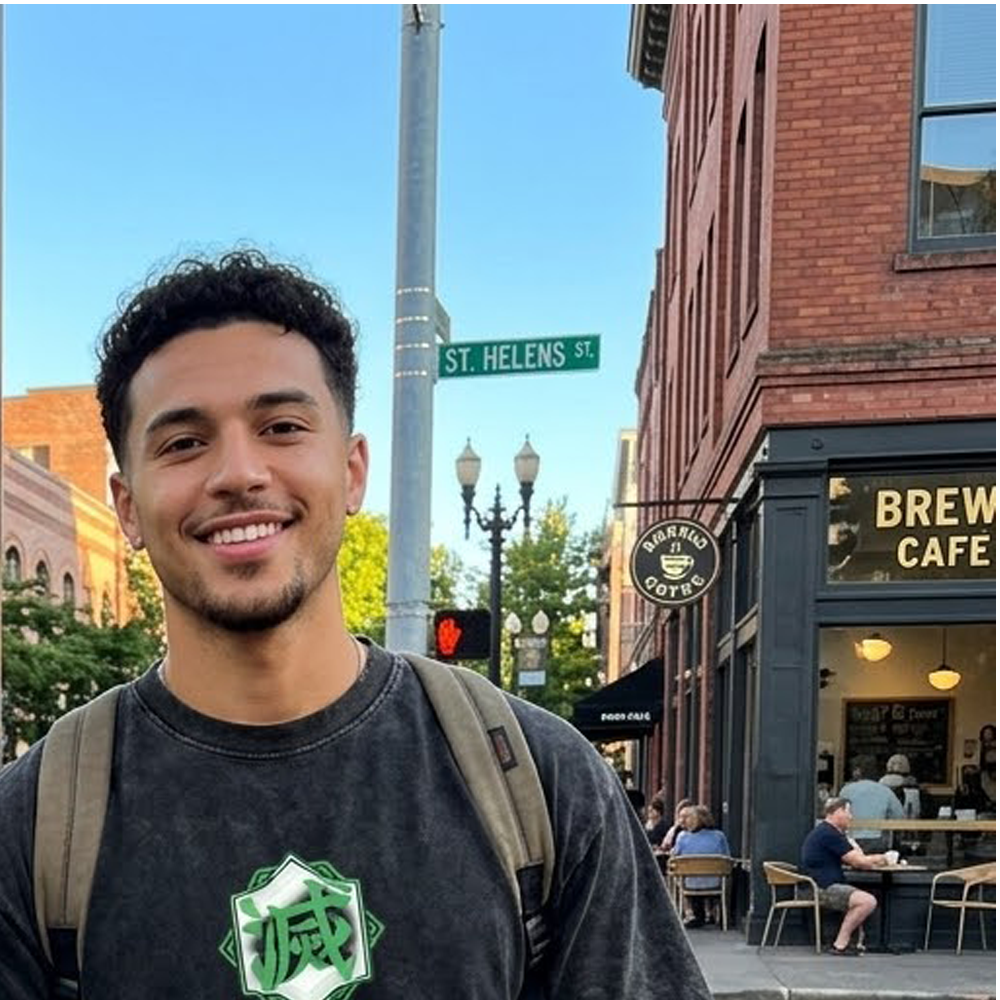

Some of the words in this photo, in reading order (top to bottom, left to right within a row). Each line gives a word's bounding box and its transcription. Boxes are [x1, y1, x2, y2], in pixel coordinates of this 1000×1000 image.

[445, 347, 475, 373] ST.
[483, 341, 566, 372] HELENS
[574, 340, 594, 359] ST.
[875, 485, 996, 528] BREW
[897, 534, 991, 569] CAFE
